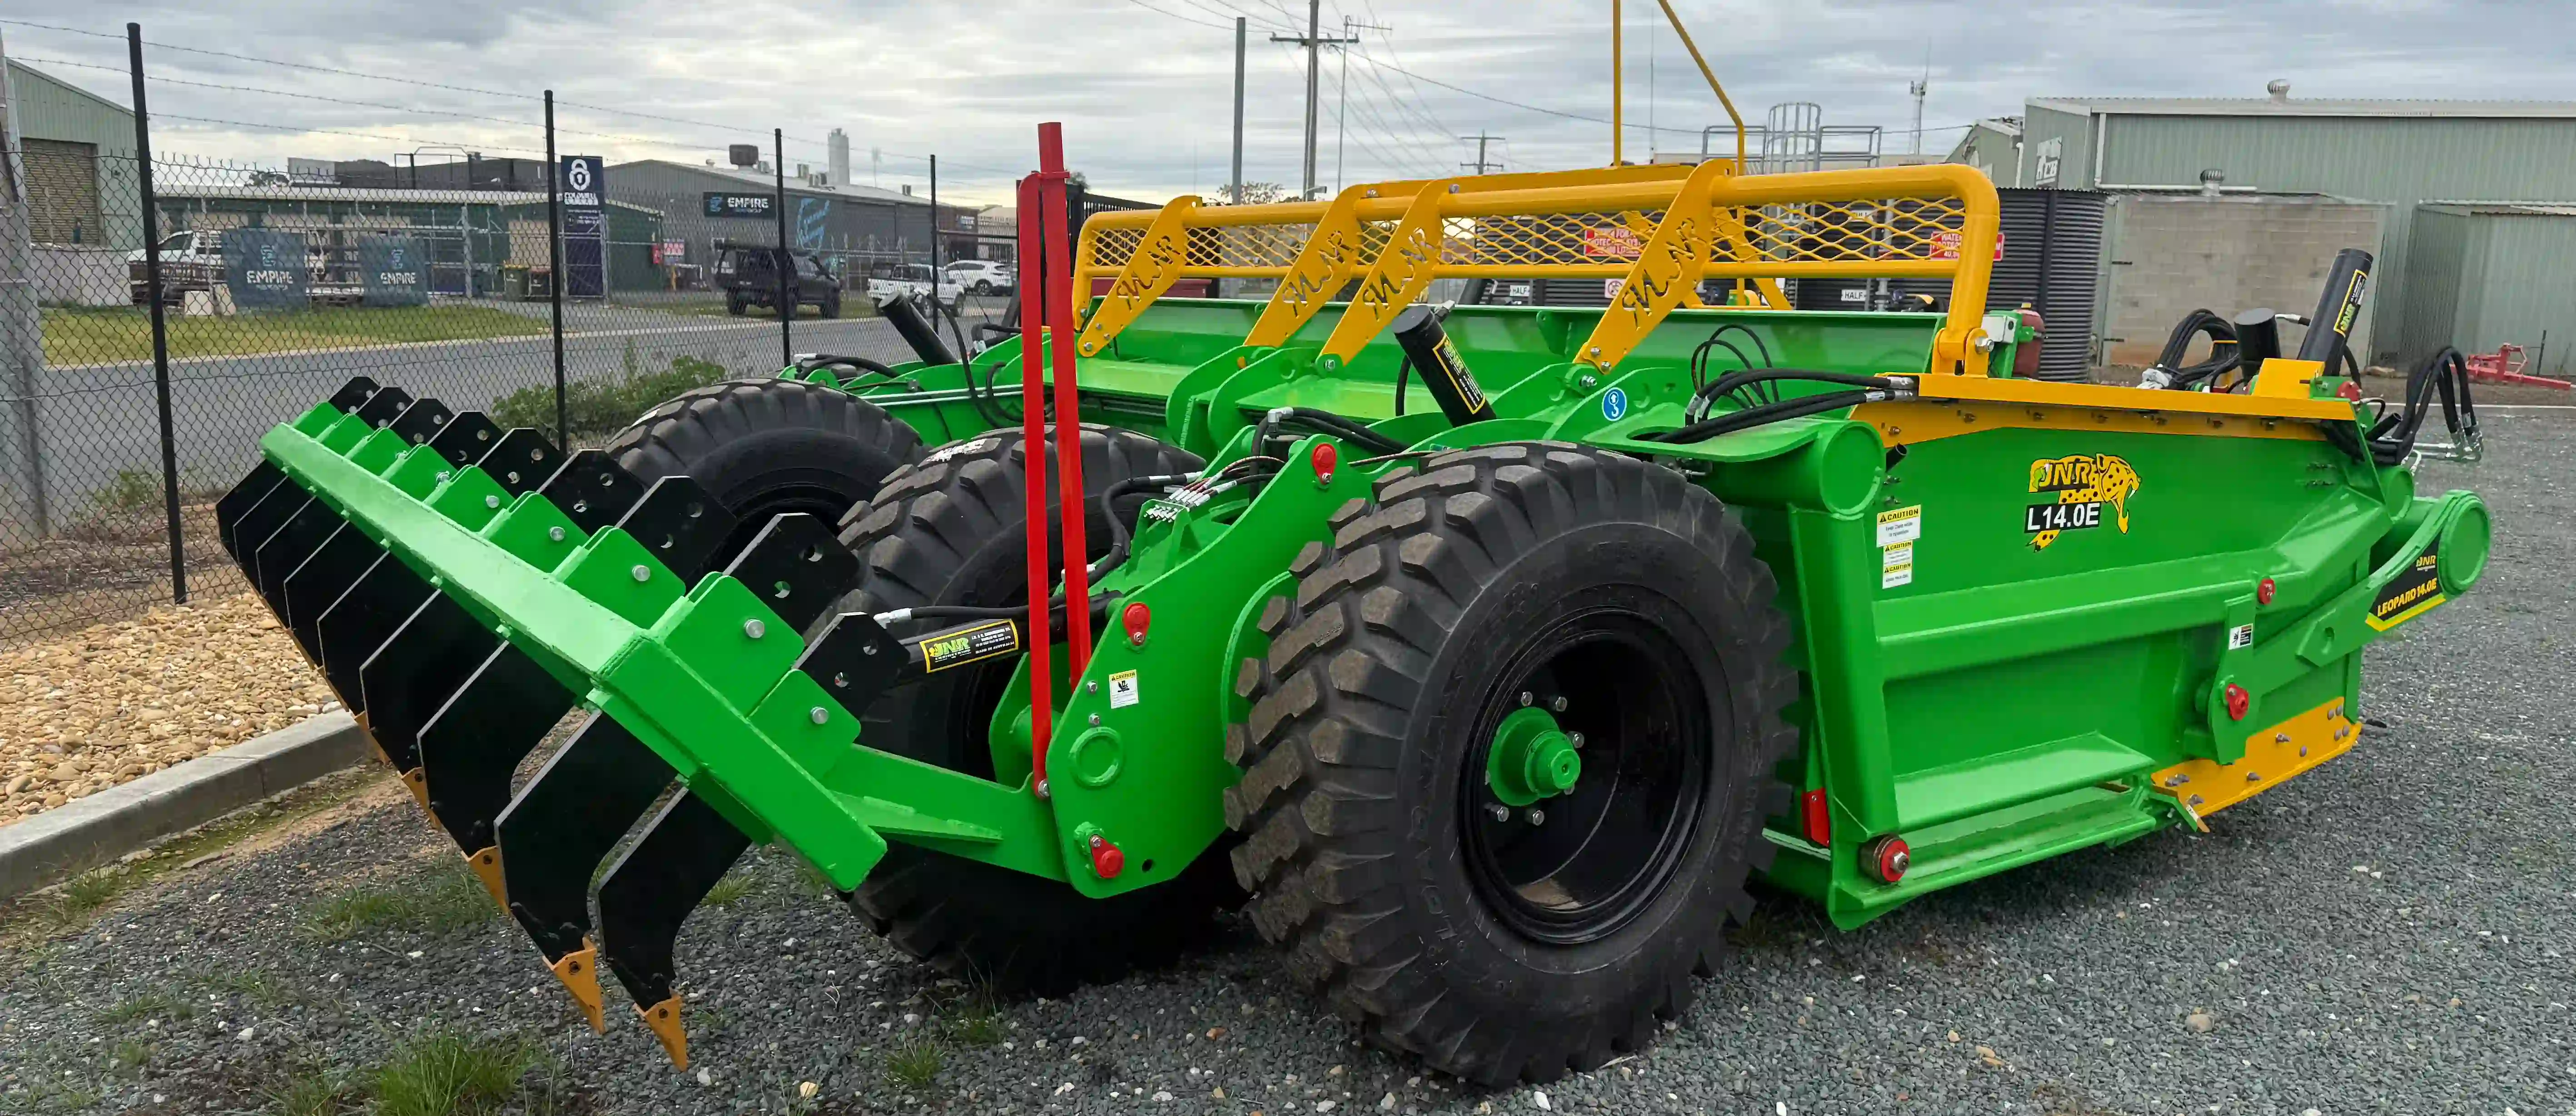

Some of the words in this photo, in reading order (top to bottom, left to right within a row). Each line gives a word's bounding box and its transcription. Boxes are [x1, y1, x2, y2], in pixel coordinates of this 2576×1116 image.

[727, 197, 769, 208] EMPIRE
[380, 272, 416, 284] EMPIRE
[2039, 461, 2091, 487] JNR
[1887, 508, 1919, 521] CAUTION
[2027, 503, 2100, 531] L14.0E
[1890, 541, 1911, 550] CAUTION
[1889, 563, 1911, 571] CAUTION
[2417, 555, 2436, 567] JNR
[2377, 587, 2417, 617] LEOPARD
[2417, 577, 2437, 597] 14.0E
[933, 637, 969, 656] JNR
